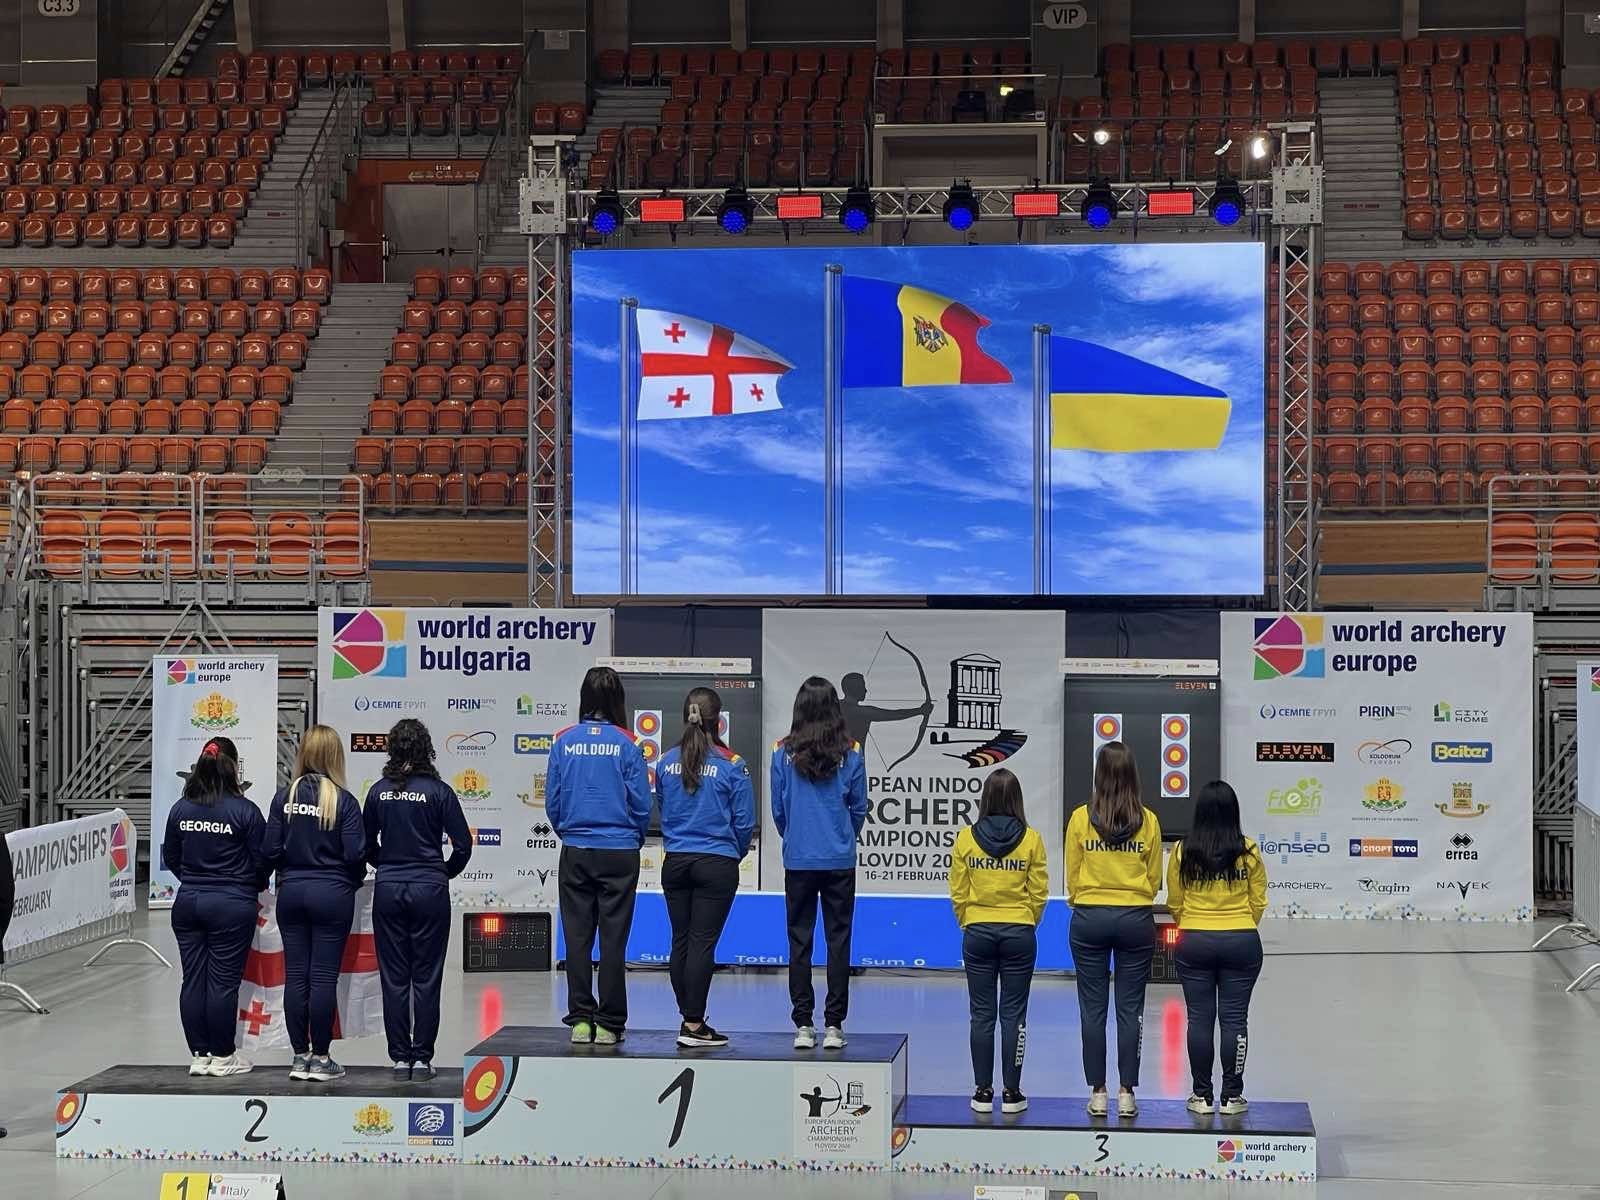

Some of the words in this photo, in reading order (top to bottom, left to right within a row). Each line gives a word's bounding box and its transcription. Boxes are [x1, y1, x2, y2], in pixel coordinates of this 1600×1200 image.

[44, 0, 74, 12] C3.3
[1053, 9, 1079, 24] VIP
[418, 615, 491, 639] world
[497, 616, 597, 645] archery
[1332, 620, 1402, 642] world
[1411, 620, 1507, 648] archery
[198, 661, 226, 670] world
[228, 661, 265, 672] archery
[420, 645, 531, 677] bulgaria
[1332, 653, 1417, 677] europe
[198, 673, 231, 683] europe
[714, 681, 747, 689] ELEVEN
[1175, 682, 1208, 690] ELEVEN
[447, 698, 481, 710] PIRIN
[1359, 705, 1395, 717] PIRIN
[356, 736, 388, 746] ELE
[516, 736, 552, 751] Beit
[564, 743, 620, 757] MOLDOVA
[1262, 744, 1323, 755] ELEVEN
[1435, 744, 1488, 760] Beiter
[664, 763, 718, 778] MOVA
[868, 776, 922, 793] PEAN
[929, 776, 983, 793] INDO
[379, 791, 427, 803] GEORGIA
[283, 803, 322, 817] GEORG
[865, 797, 982, 826] RCHER
[179, 820, 233, 835] GEORGIA
[526, 839, 556, 849] errea
[856, 830, 956, 847] AMPIONS
[1085, 839, 1145, 853] UKRAINE
[12, 826, 107, 881] AMPIONSHIPS
[859, 853, 926, 867] LOVDIV
[932, 853, 952, 868] 20
[1445, 850, 1478, 860] errea
[968, 856, 1027, 872] UKRAINE
[463, 870, 494, 881] agim
[517, 868, 558, 887] NAVE
[865, 870, 894, 880] 16-21
[897, 871, 949, 881] FEBRUAR
[1436, 881, 1491, 900] NAVEK
[12, 888, 52, 918] EBRUARY
[736, 955, 784, 964] Total
[861, 957, 905, 966] Sum
[1014, 1023, 1026, 1067] Joma
[1235, 1034, 1247, 1075] Joma
[658, 1067, 695, 1149] 1
[244, 1098, 269, 1142] 2
[810, 1126, 856, 1136] ARCHERY
[1094, 1134, 1110, 1162] 3
[1245, 1143, 1270, 1151] world
[1272, 1144, 1307, 1154] archery
[1245, 1154, 1276, 1163] europe
[176, 1175, 189, 1200] 1
[226, 1186, 250, 1198] Italy
